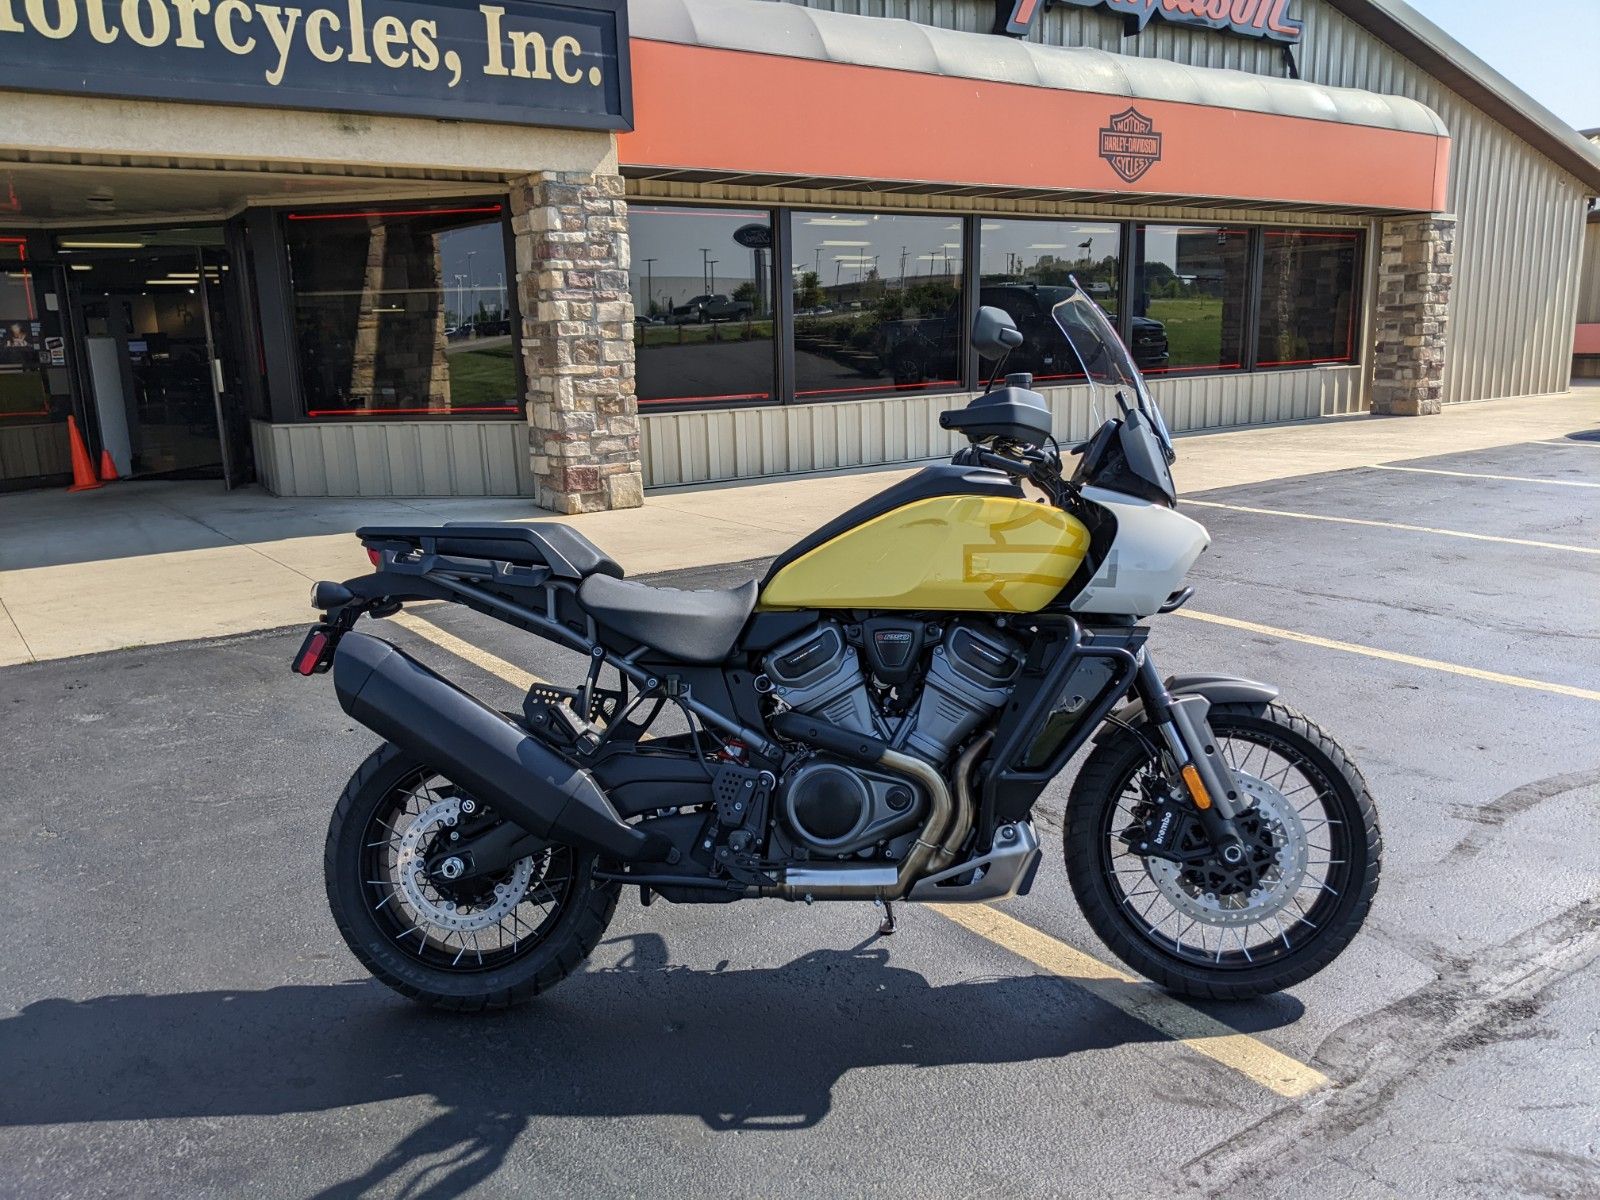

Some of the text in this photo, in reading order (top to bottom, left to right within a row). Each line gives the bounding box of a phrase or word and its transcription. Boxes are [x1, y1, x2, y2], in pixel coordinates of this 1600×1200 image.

[0, 0, 602, 87] otorcycles, Inc.
[1117, 116, 1146, 133] MOTOR
[1104, 135, 1157, 154] HARLEY-DAVIDSON
[1116, 157, 1145, 176] CYCLES
[1154, 811, 1172, 844] brembo
